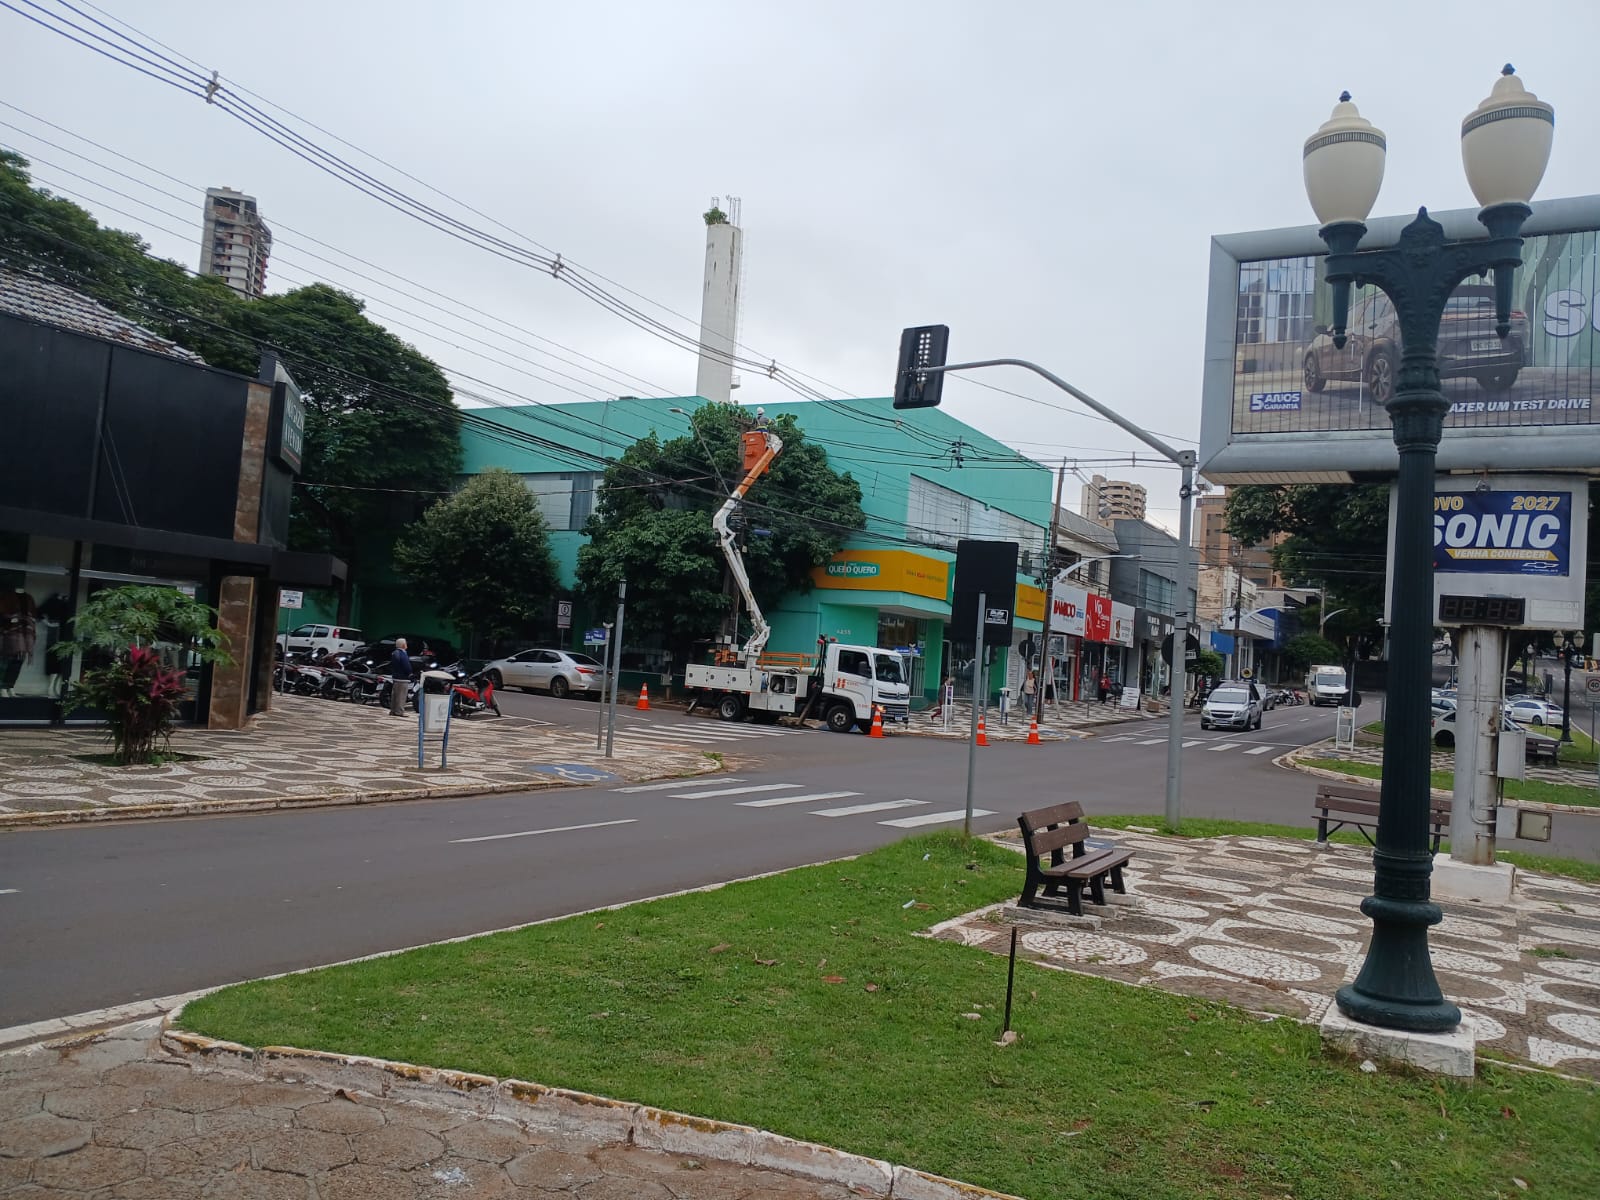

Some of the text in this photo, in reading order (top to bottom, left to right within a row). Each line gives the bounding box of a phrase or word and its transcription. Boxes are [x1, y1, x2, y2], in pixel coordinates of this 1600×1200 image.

[1543, 289, 1600, 337] S
[1251, 393, 1300, 411] 5 ANOS
[1448, 398, 1591, 413] AZER UM TEST DRIVE
[1434, 495, 1561, 511] OVO 2027
[1454, 549, 1549, 560] VENHA CONHECER!
